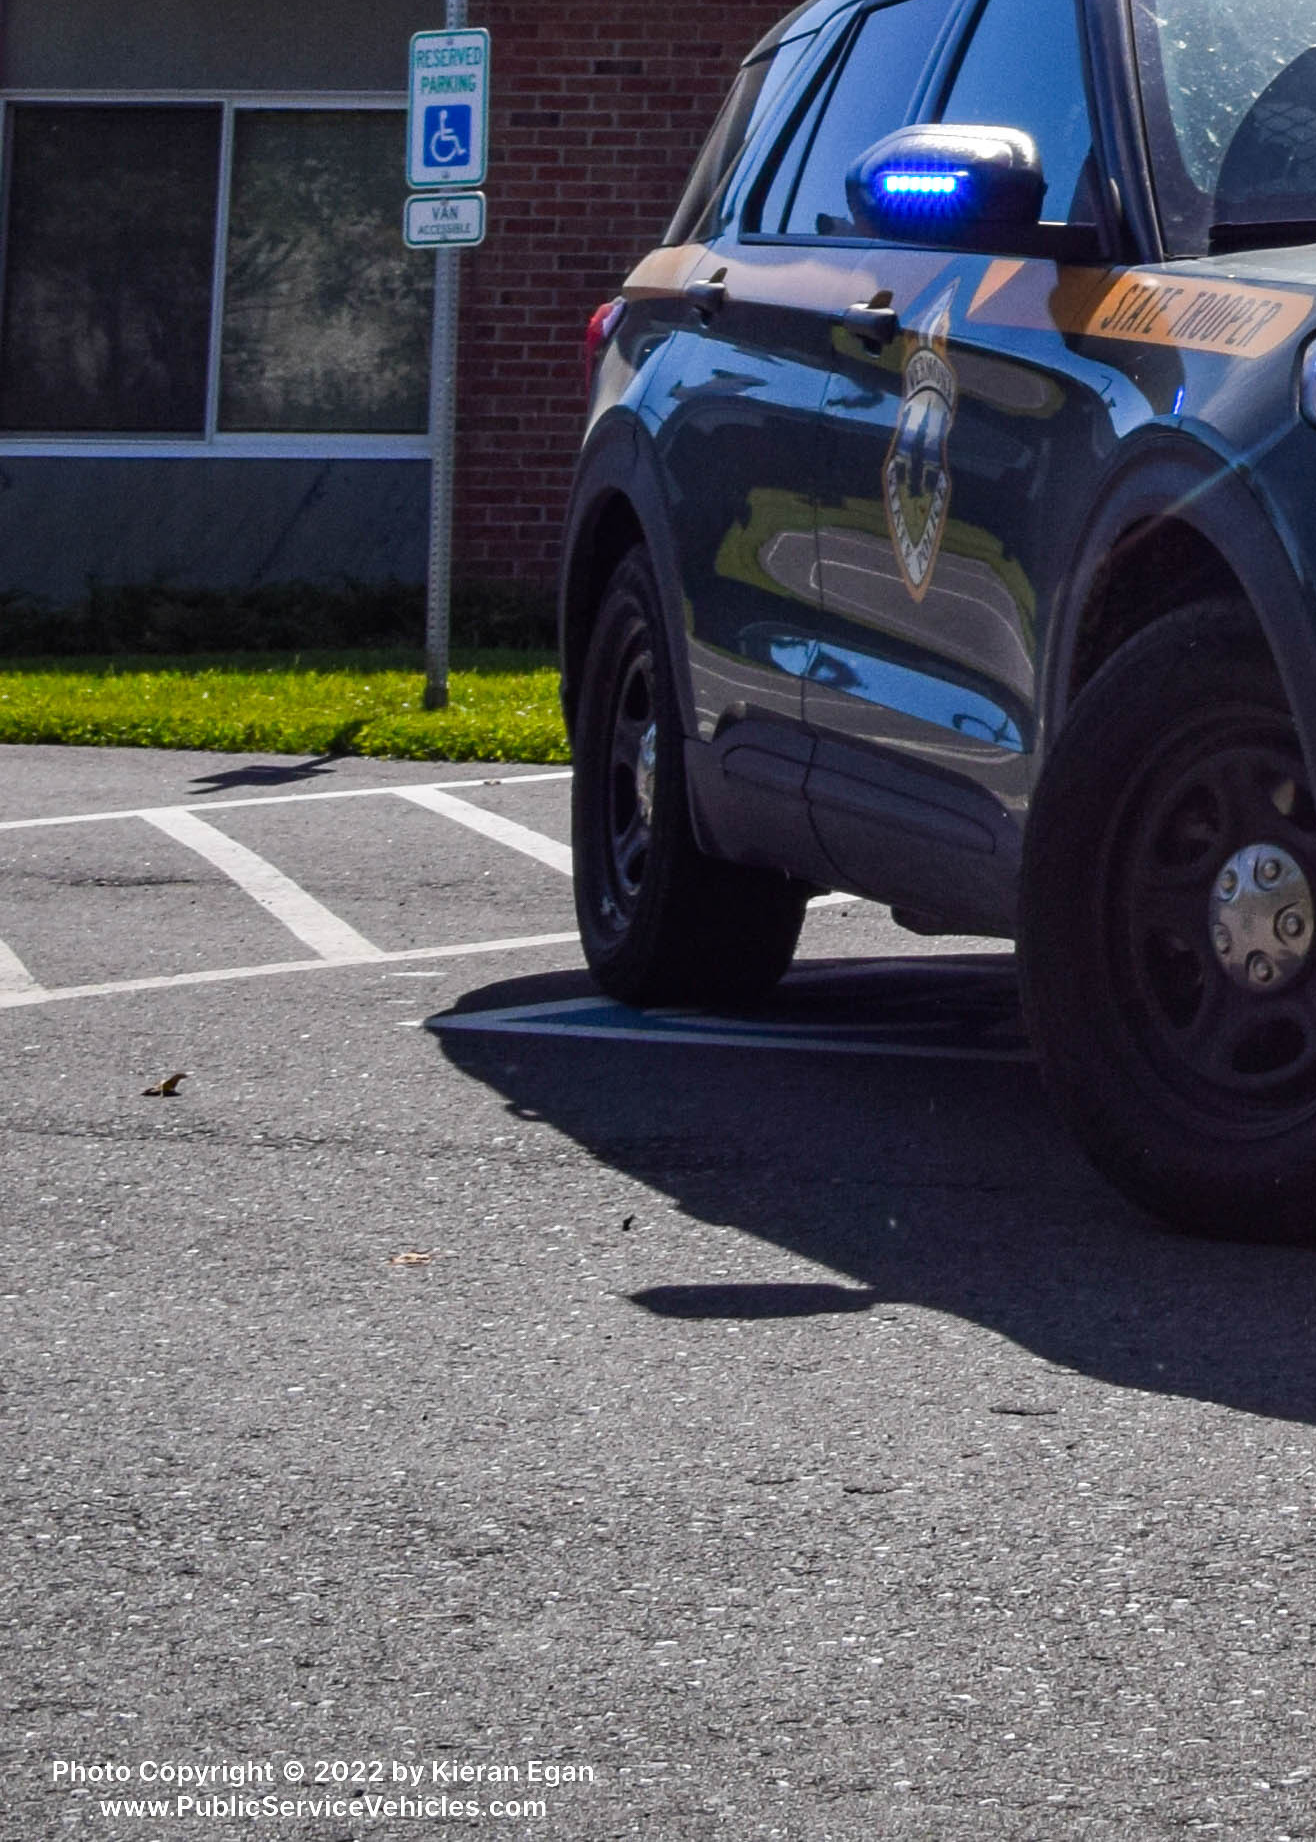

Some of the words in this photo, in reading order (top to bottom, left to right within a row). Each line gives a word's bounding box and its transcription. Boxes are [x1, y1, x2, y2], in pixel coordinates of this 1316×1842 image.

[415, 46, 482, 69] RESERVED
[420, 73, 477, 94] PARKING
[431, 205, 459, 221] VAN
[417, 222, 472, 235] ACCESSIBLE
[1100, 283, 1184, 334] STATE
[1167, 290, 1284, 347] TROOPER
